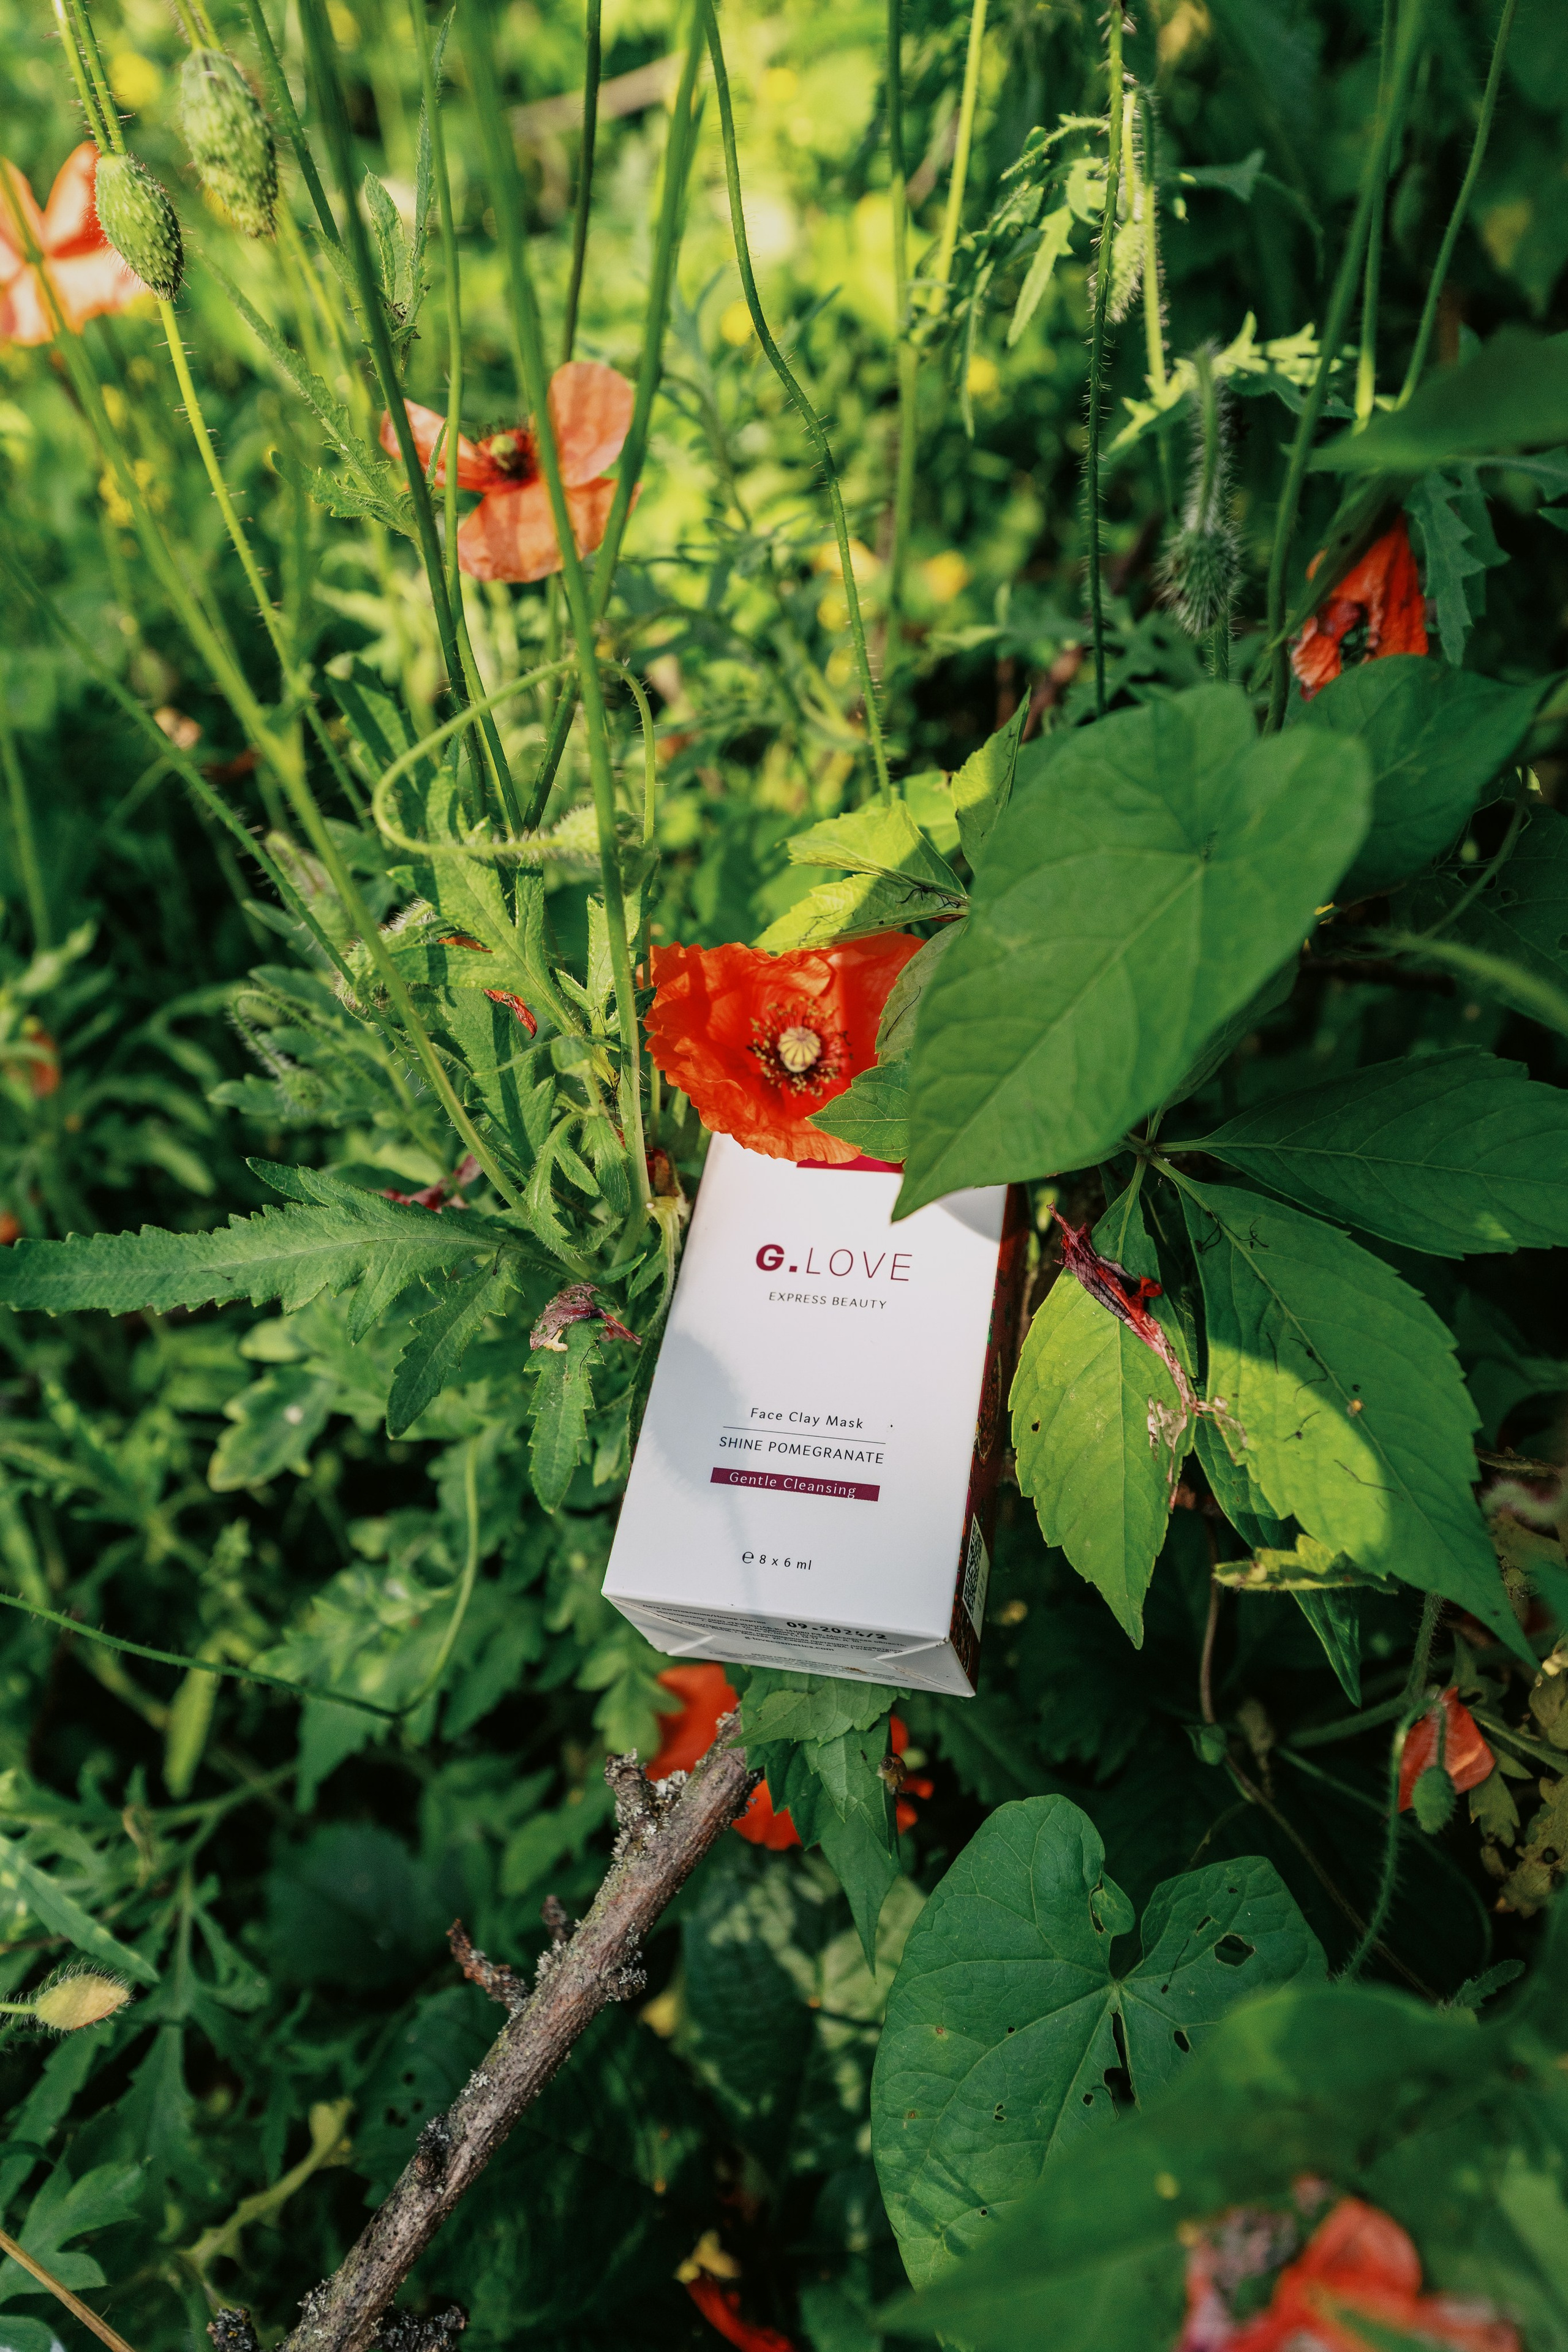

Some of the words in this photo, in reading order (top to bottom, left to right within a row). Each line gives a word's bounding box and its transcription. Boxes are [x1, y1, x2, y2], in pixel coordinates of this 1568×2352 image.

[756, 1244, 912, 1281] G.LOVE
[769, 1292, 827, 1305] EXPRESS
[832, 1297, 887, 1310] BEAUTY
[750, 1408, 783, 1421] Face
[789, 1411, 820, 1427] Clay
[826, 1415, 864, 1429] Mask
[718, 1436, 763, 1451] SHINE
[768, 1441, 885, 1464] POMEGRANATE
[729, 1472, 777, 1487] Gentle
[783, 1477, 856, 1499] Cleansing
[759, 1554, 767, 1564] 8
[771, 1558, 779, 1566] x
[783, 1557, 791, 1567] 6
[796, 1559, 812, 1570] ml
